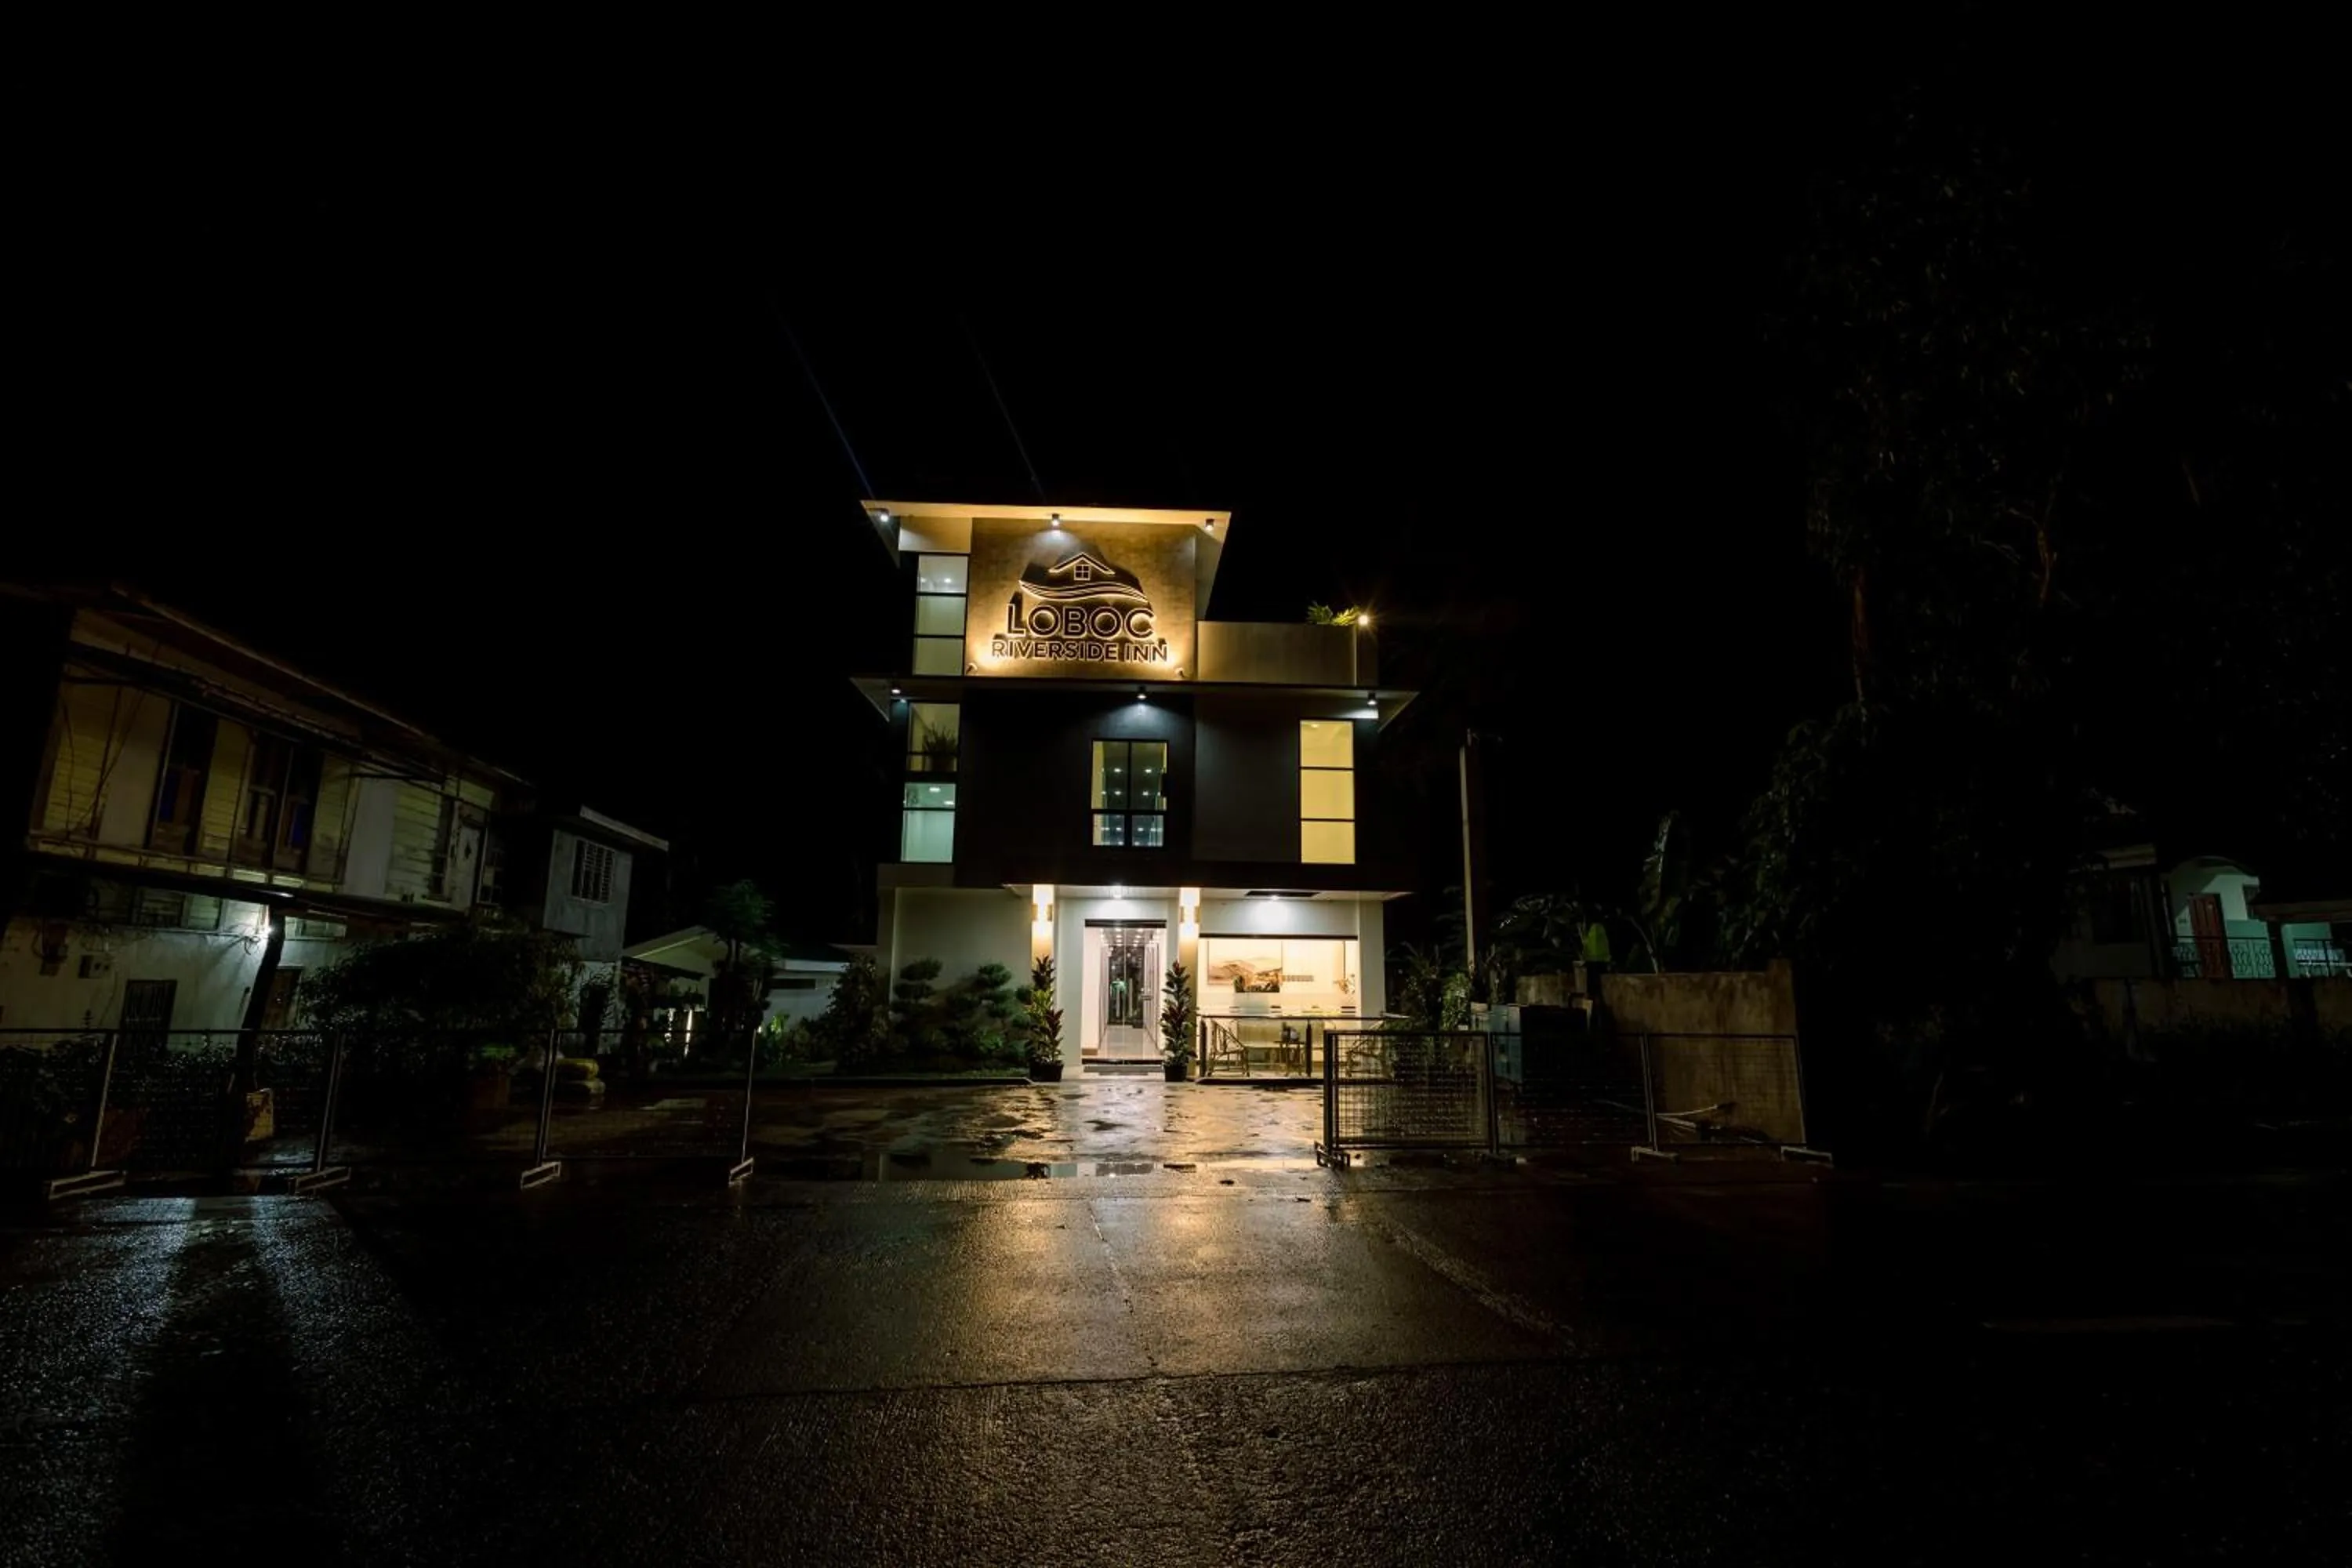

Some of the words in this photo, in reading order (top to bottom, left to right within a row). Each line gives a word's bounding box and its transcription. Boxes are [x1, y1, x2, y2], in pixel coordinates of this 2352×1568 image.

[1007, 604, 1155, 639] LOBOC
[993, 640, 1119, 662] RIVERSIDE
[1124, 644, 1167, 662] INN
